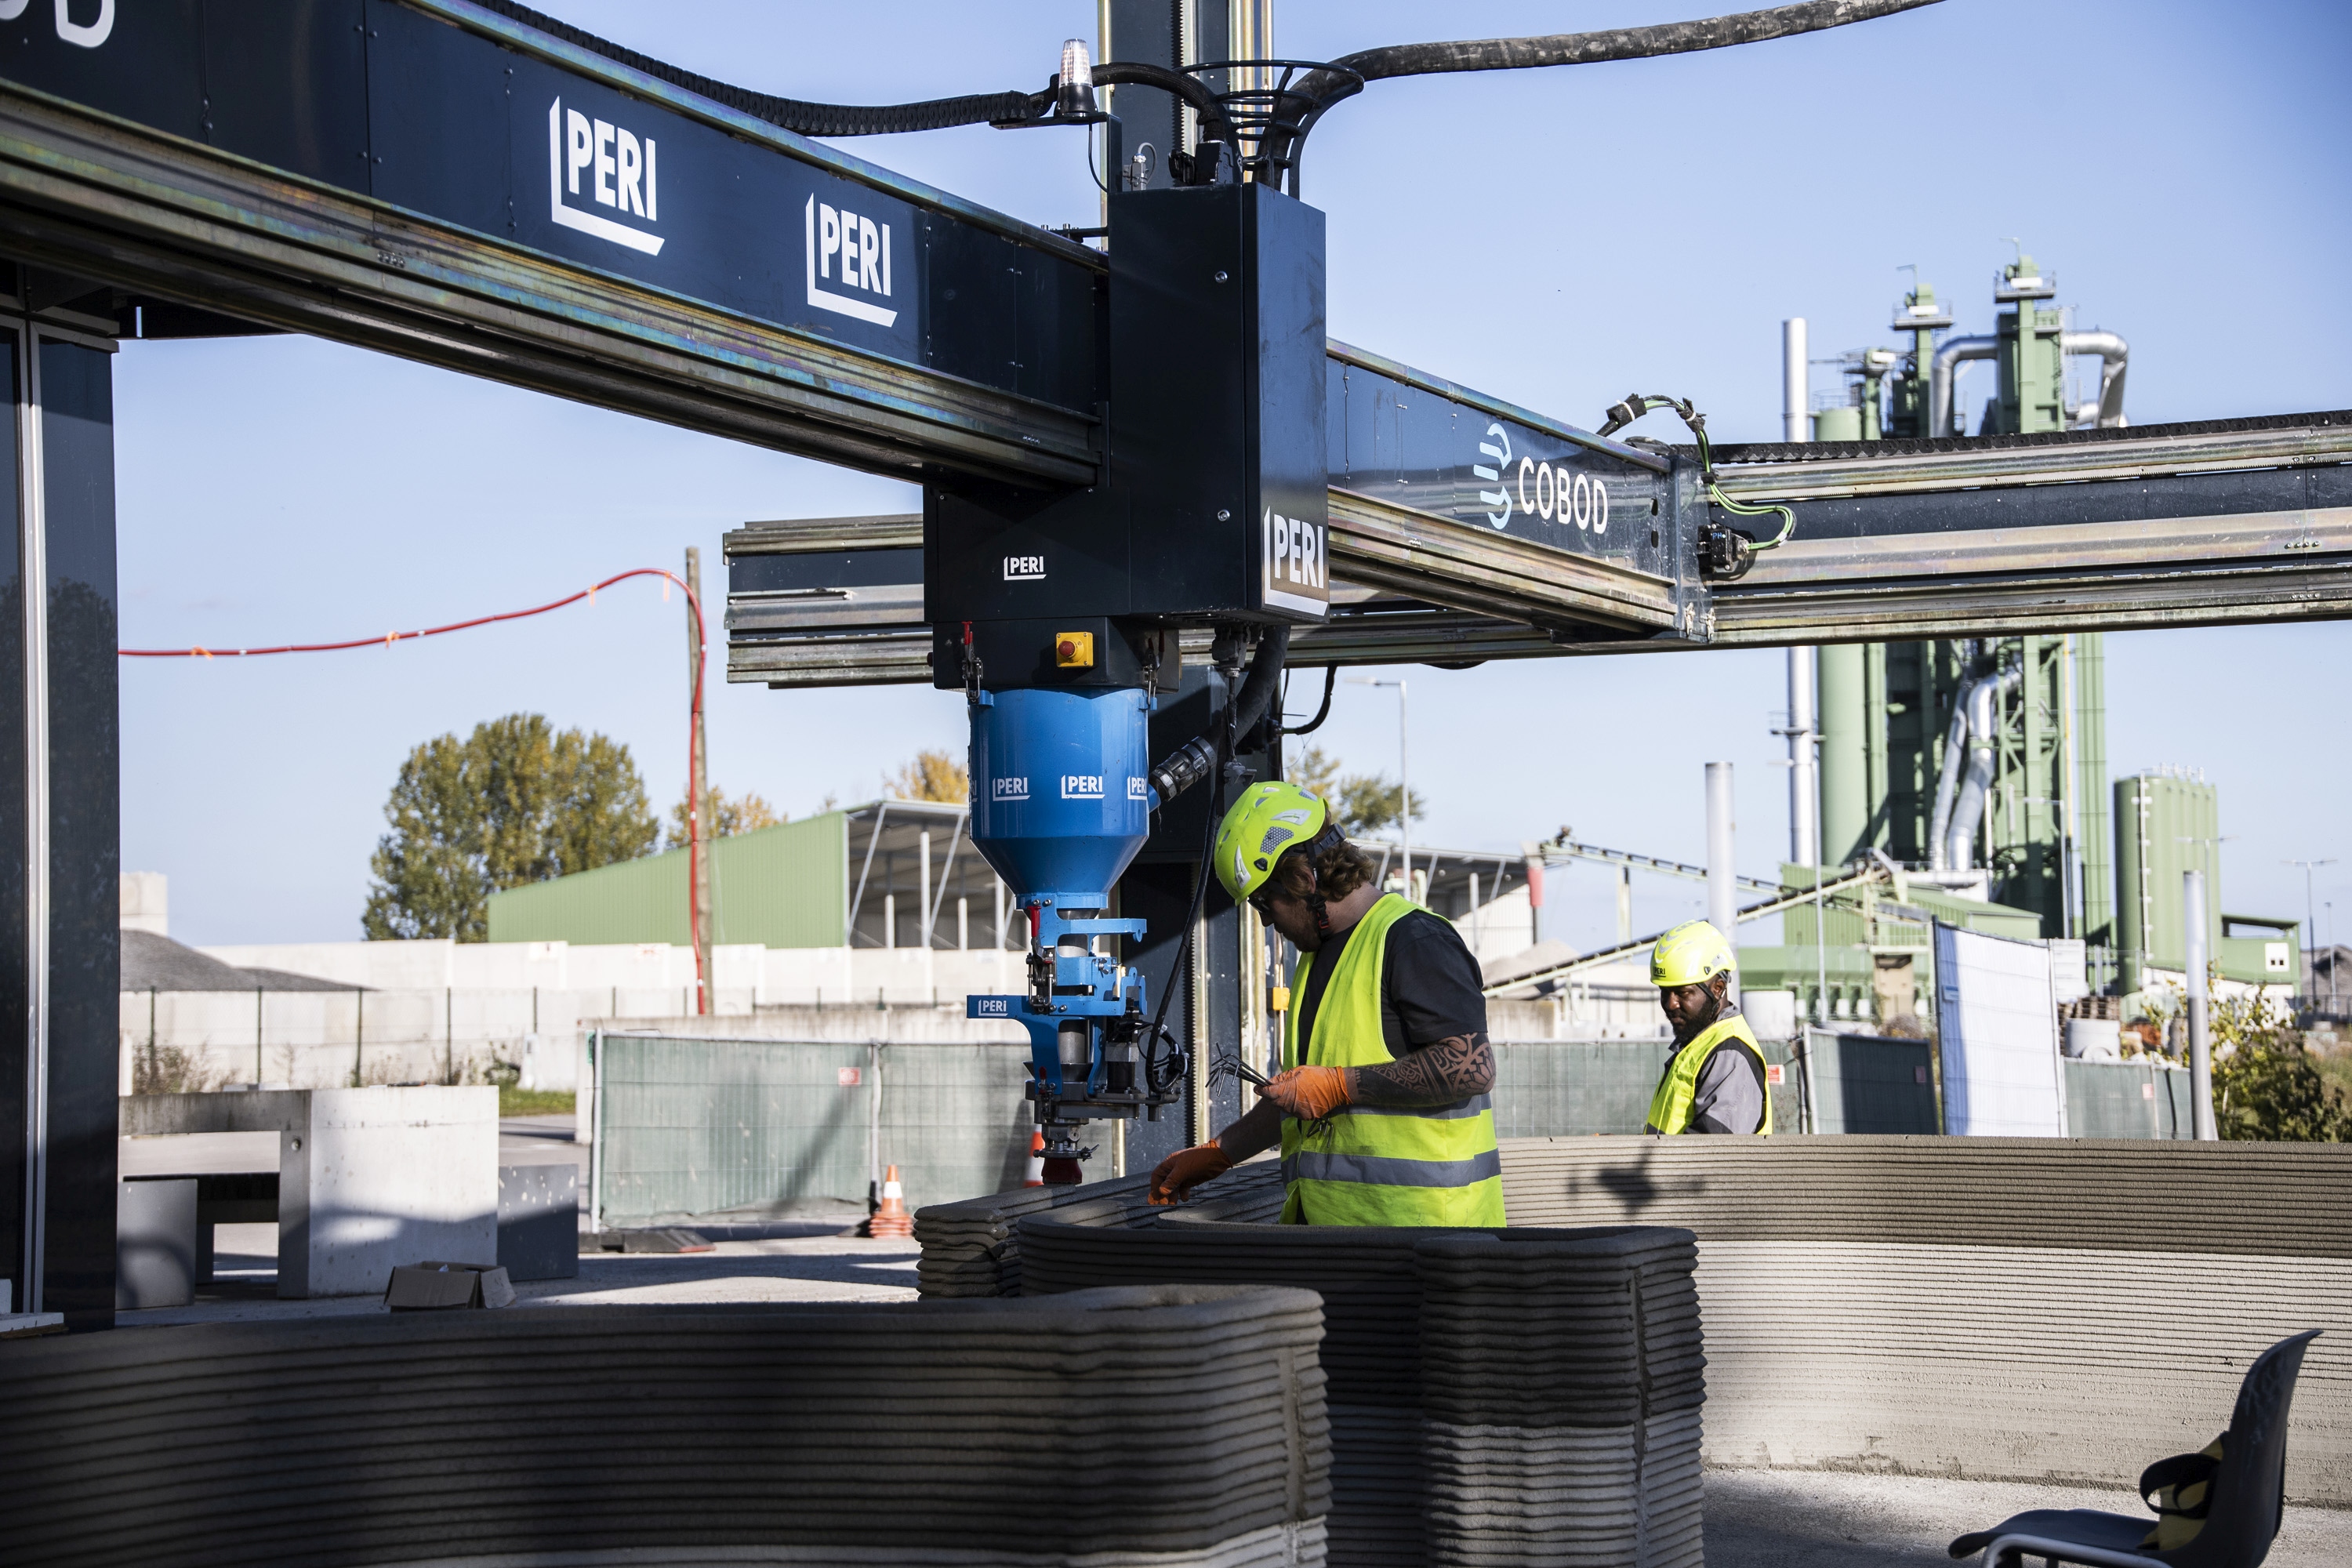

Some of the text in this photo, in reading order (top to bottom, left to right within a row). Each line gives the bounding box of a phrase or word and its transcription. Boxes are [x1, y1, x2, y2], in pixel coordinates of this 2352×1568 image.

[567, 108, 657, 222] PERI
[819, 202, 891, 296] PERI
[1519, 456, 1608, 535] COBOD
[1274, 514, 1324, 589] PERI
[1010, 556, 1044, 574] PERI
[997, 777, 1028, 795] PERI
[1068, 775, 1103, 793] PERI
[1131, 777, 1147, 794] PERI
[1654, 966, 1666, 975] PERI
[982, 1000, 1007, 1012] PERI
